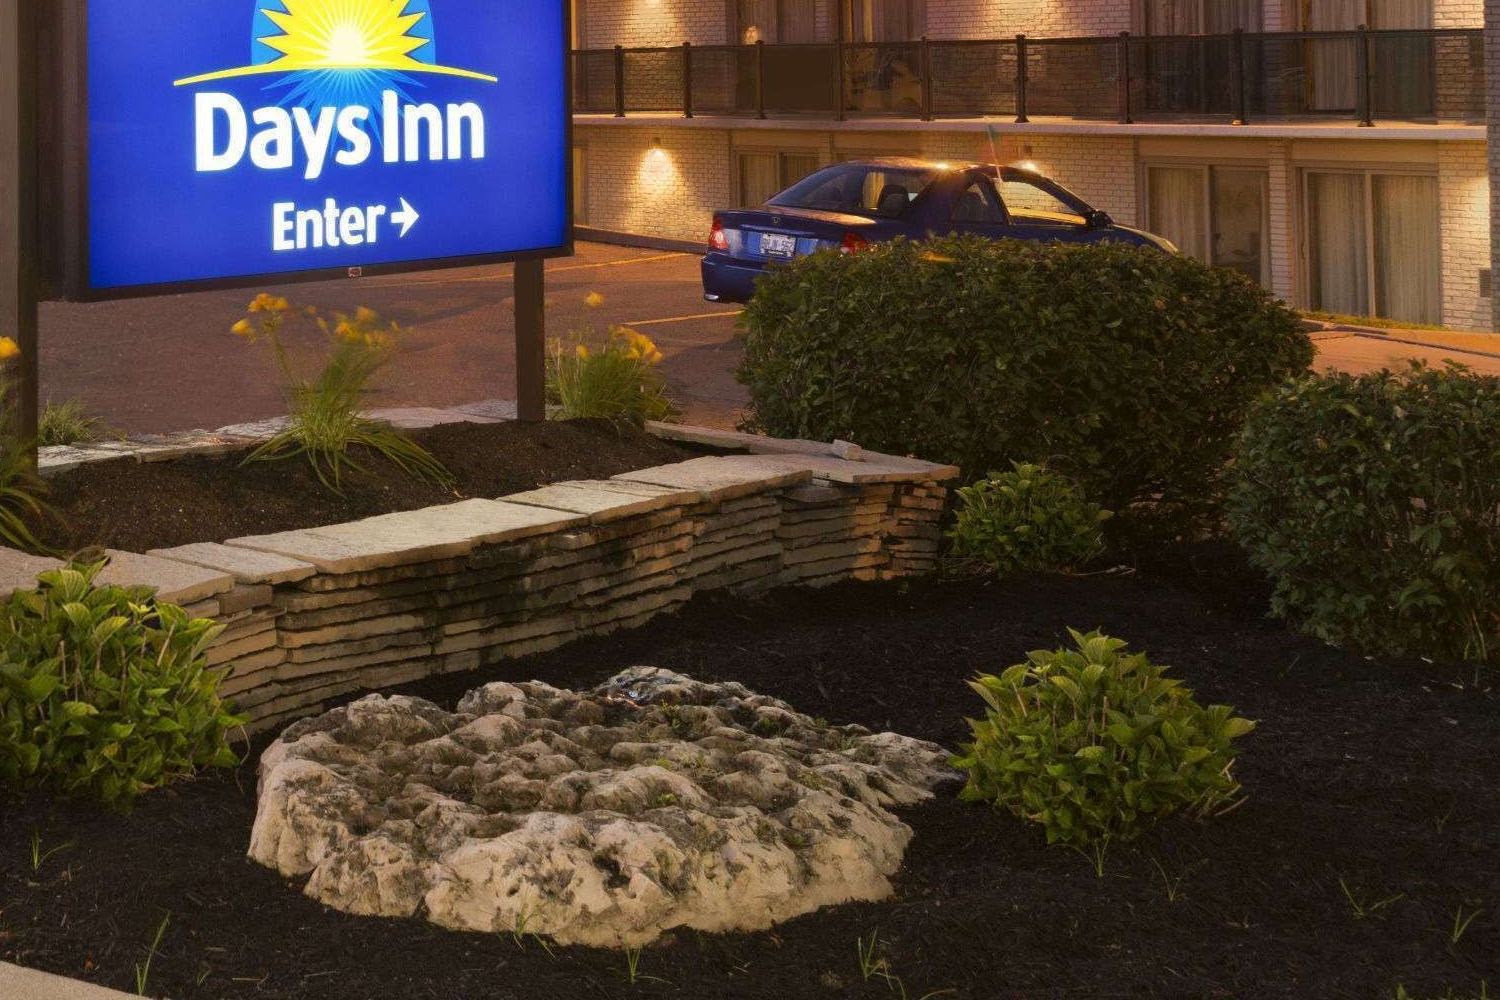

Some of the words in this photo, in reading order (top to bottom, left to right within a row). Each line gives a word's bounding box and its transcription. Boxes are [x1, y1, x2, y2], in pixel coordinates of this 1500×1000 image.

[195, 92, 371, 179] Days
[383, 89, 485, 163] Inn
[273, 198, 386, 250] Enter
